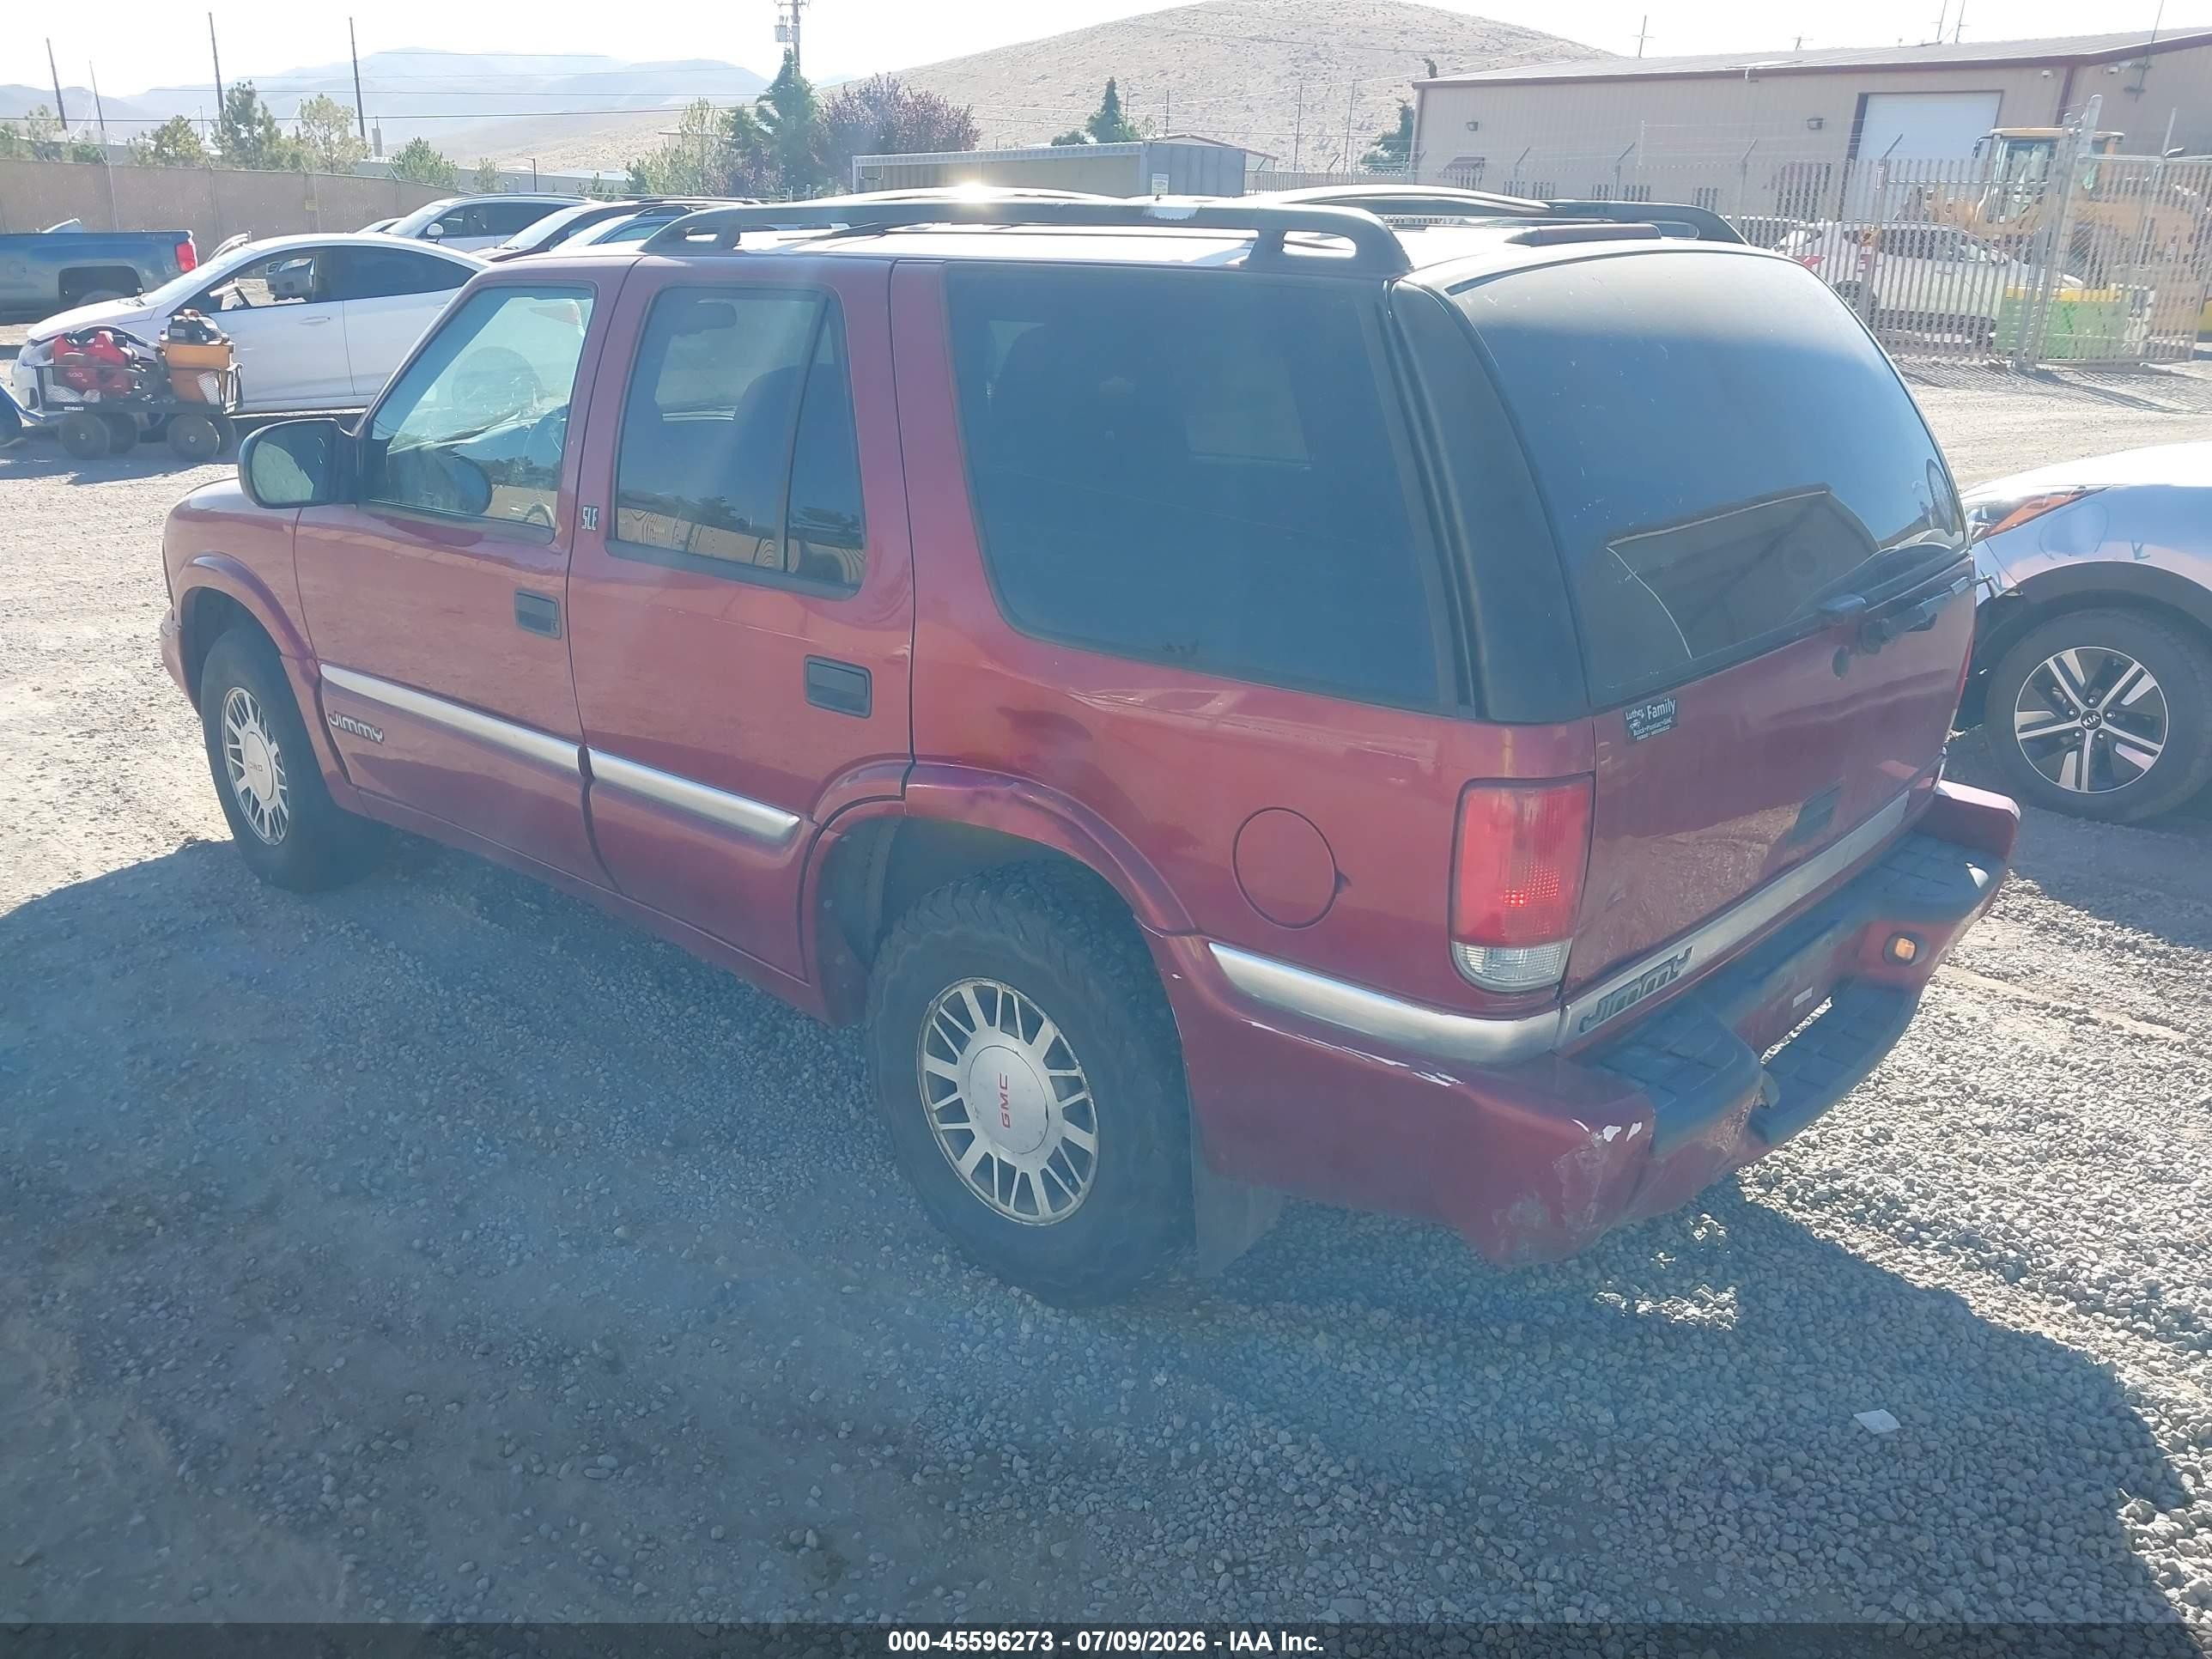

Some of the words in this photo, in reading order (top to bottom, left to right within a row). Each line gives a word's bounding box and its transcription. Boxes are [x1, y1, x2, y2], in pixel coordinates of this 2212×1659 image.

[580, 506, 599, 531] SLE
[1645, 696, 1676, 720] Family
[2082, 714, 2100, 727] KIA
[999, 1073, 1012, 1129] GMC
